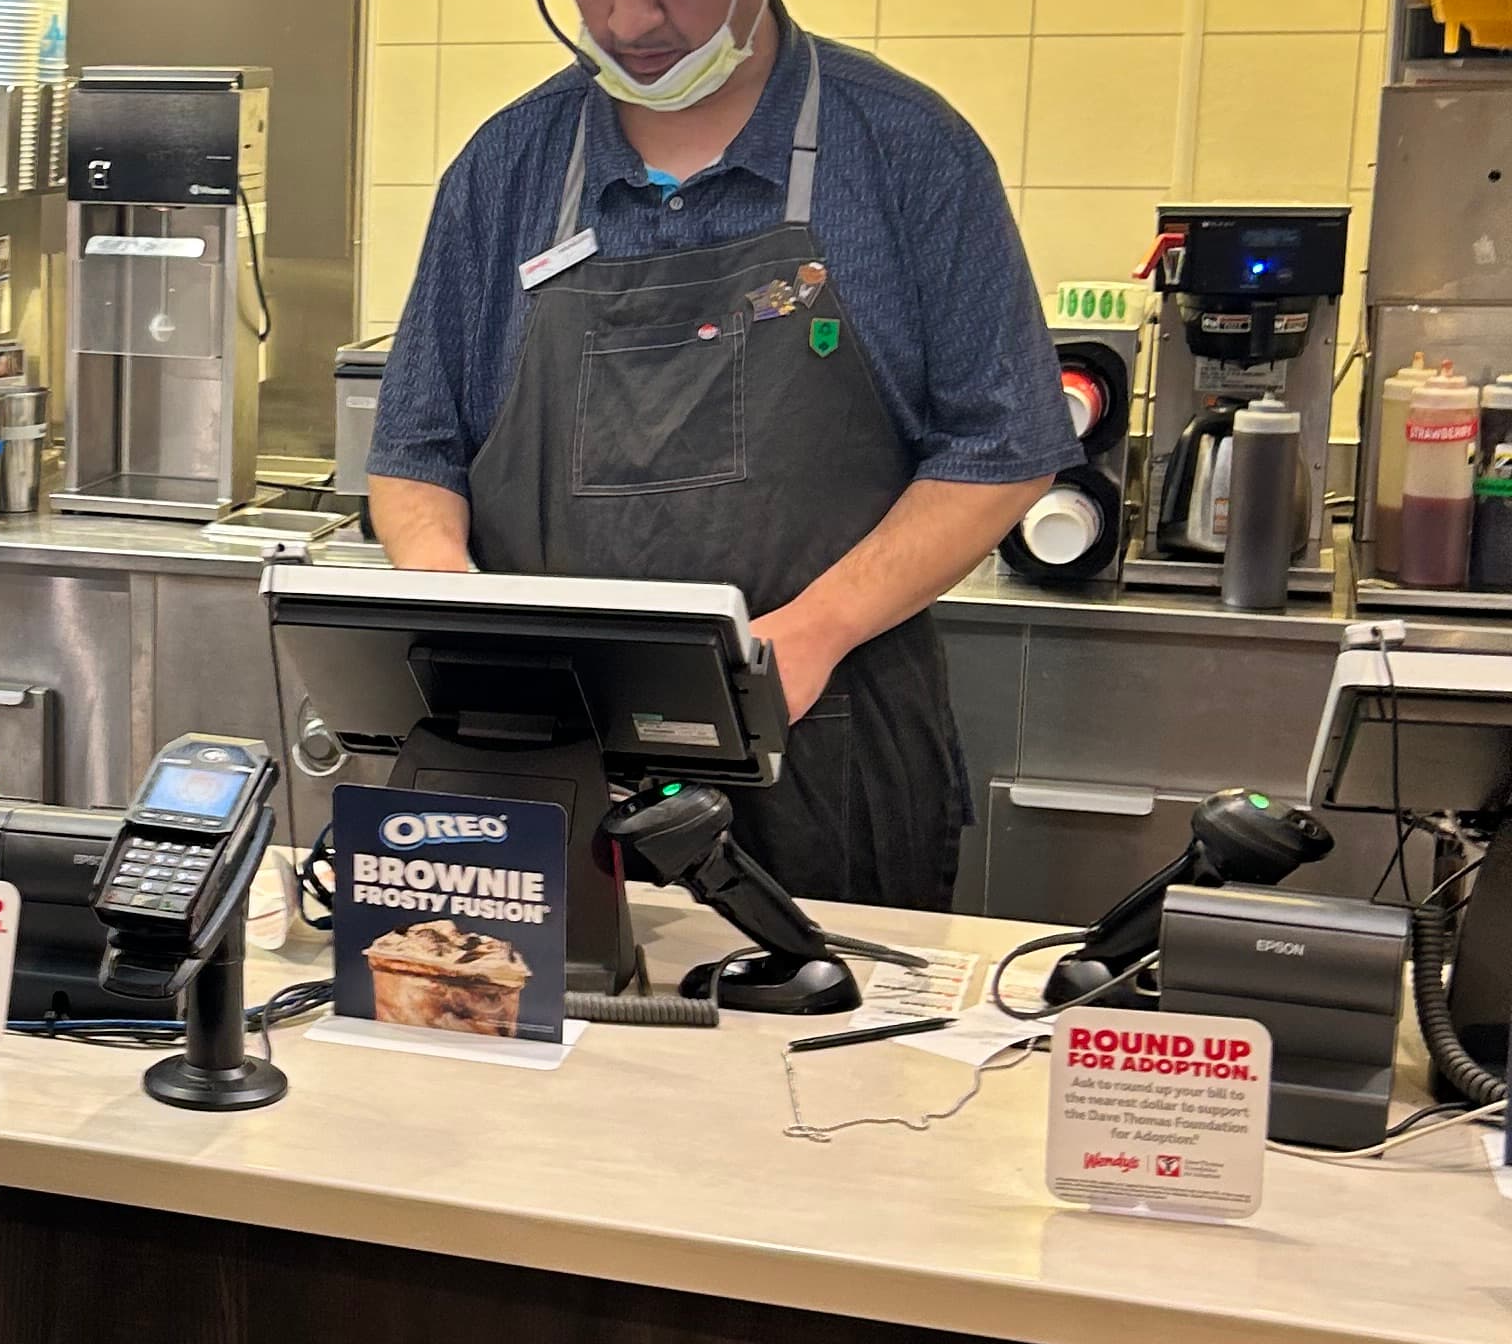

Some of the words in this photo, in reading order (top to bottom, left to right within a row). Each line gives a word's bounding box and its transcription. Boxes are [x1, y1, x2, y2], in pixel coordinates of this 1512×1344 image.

[383, 814, 508, 845] OREO
[353, 853, 544, 902] BROWNIE
[353, 884, 448, 912] FROSTY
[1256, 938, 1306, 956] EPSON
[1069, 1028, 1194, 1058] ROUND
[1204, 1037, 1251, 1061] UP
[1067, 1053, 1115, 1070] FOR
[1120, 1056, 1258, 1082] ADOPTION.
[1072, 1076, 1096, 1089] Ask
[1097, 1079, 1113, 1090] to
[1114, 1081, 1153, 1094] round
[1155, 1086, 1173, 1097] up
[1174, 1087, 1205, 1099] your
[1207, 1087, 1227, 1100] bill
[1229, 1089, 1245, 1101] to
[1064, 1092, 1087, 1104] the
[1088, 1096, 1139, 1108] nearest
[1140, 1098, 1177, 1111] dollar
[1181, 1102, 1194, 1114] to
[1196, 1104, 1251, 1119] support
[1064, 1108, 1087, 1120] the
[1088, 1109, 1121, 1123] Dave
[1123, 1112, 1172, 1128] Thomas
[1175, 1117, 1248, 1134] Foundation
[1110, 1127, 1131, 1140] for
